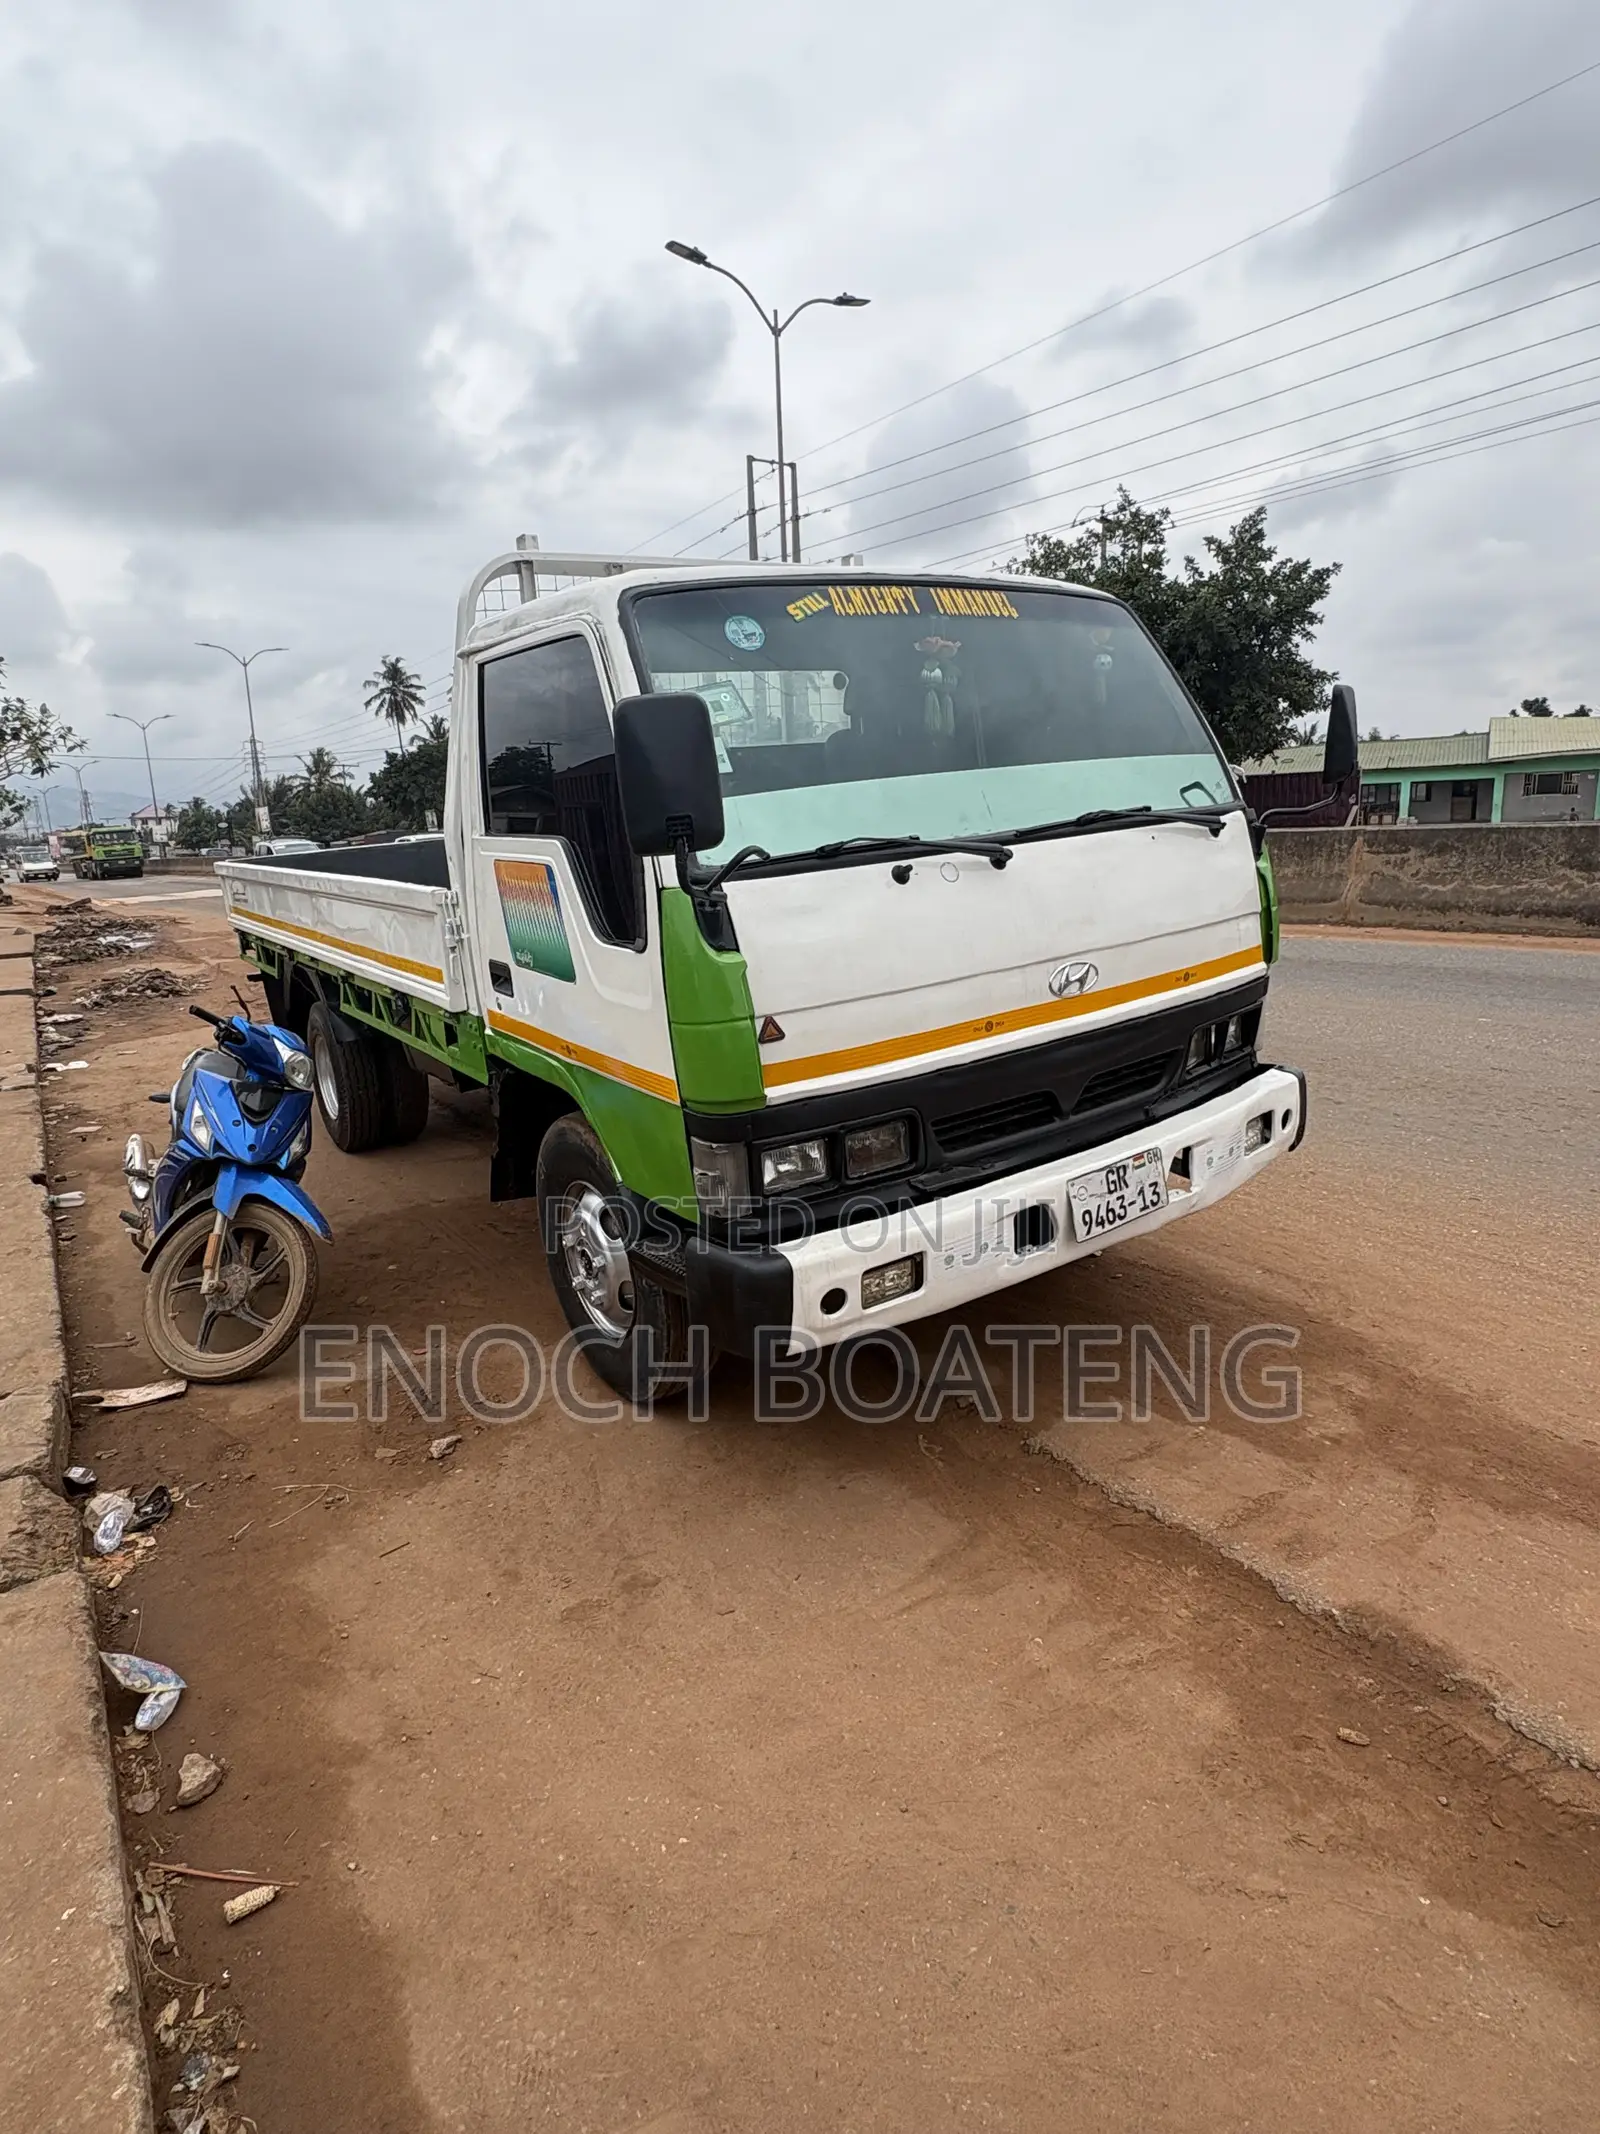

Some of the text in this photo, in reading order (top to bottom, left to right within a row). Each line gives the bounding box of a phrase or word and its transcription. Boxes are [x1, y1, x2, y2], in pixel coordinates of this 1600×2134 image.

[786, 585, 1019, 622] STILL ALMIGHTY IMMANUEL
[1105, 1164, 1129, 1195] GR
[1081, 1180, 1161, 1237] 9463-13
